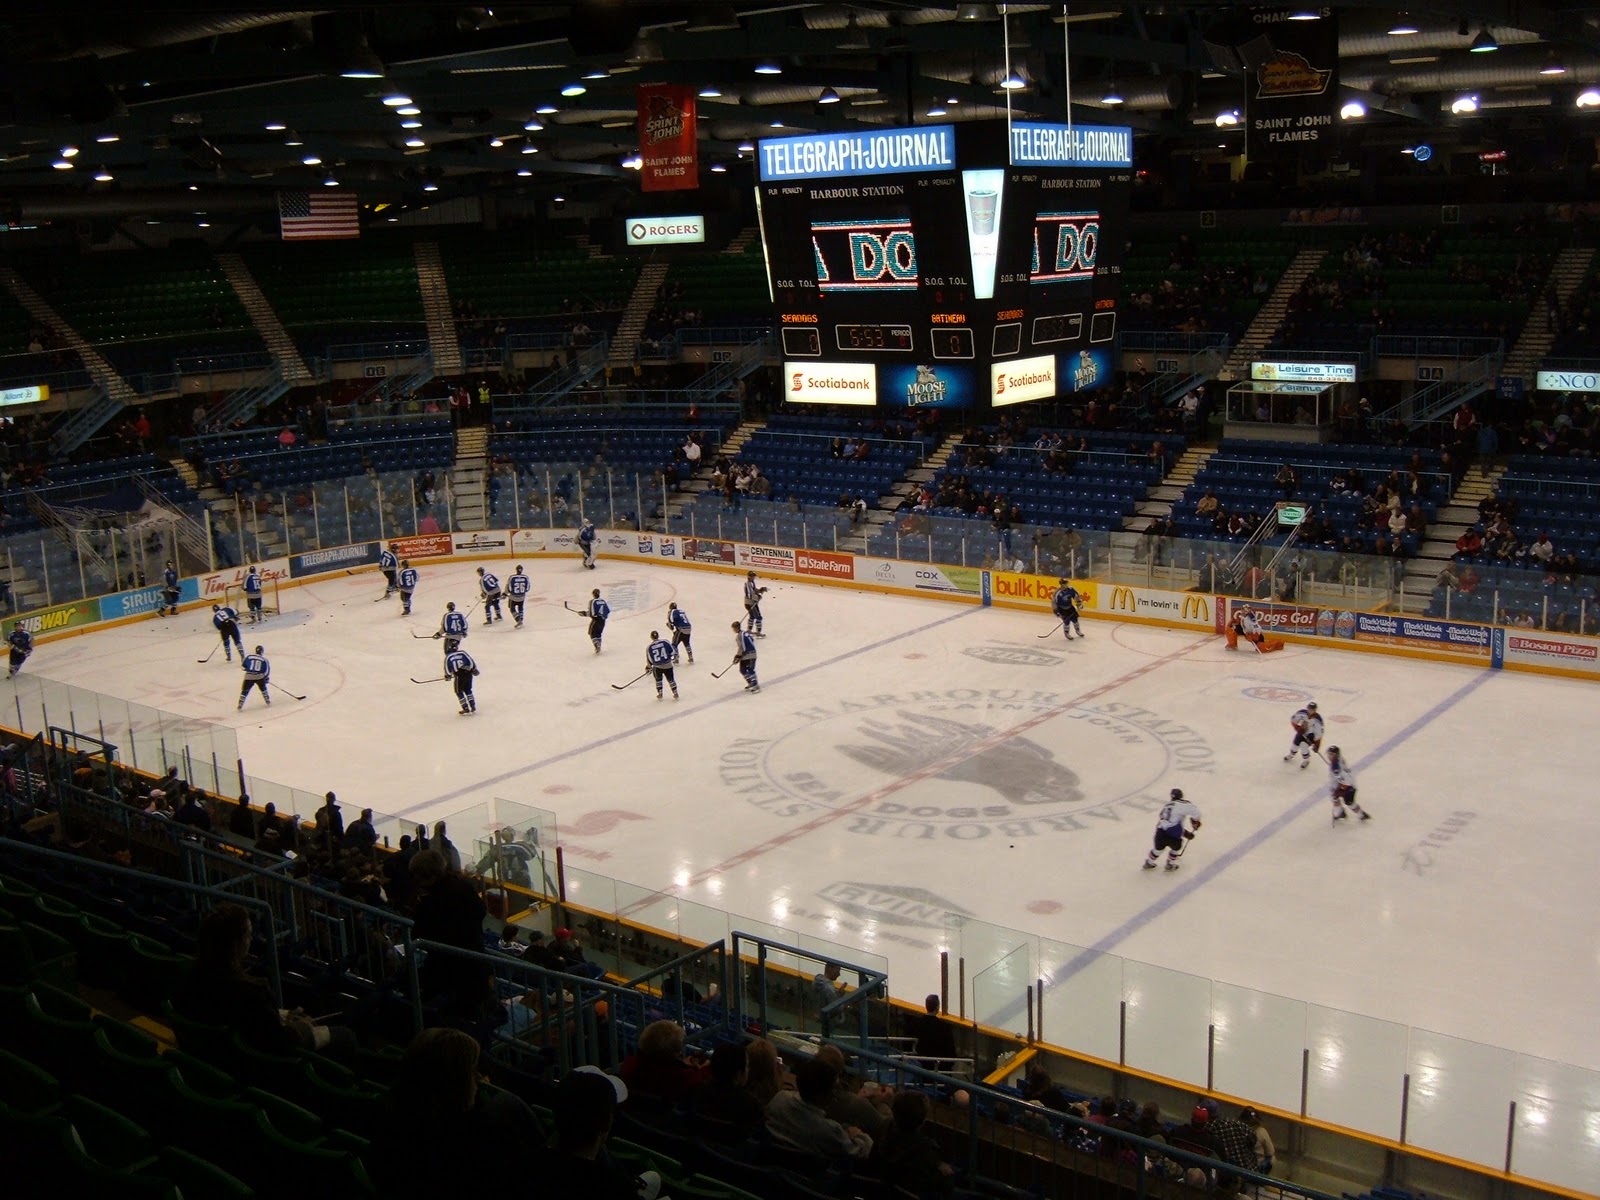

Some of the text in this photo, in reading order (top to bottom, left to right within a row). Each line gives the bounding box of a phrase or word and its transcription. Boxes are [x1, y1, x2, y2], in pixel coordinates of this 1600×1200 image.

[1255, 115, 1332, 130] SAINT JOHN
[653, 126, 683, 139] JOHN
[1269, 130, 1319, 142] FLAMES
[763, 131, 952, 176] TELEGRAPH-JOURNAL
[645, 156, 693, 167] SAINT JOHN
[653, 167, 686, 177] FLAMES
[1041, 179, 1102, 189] HARBOUR STATION
[810, 185, 905, 200] HARBOUR STATION
[650, 224, 699, 236] ROGERS
[781, 314, 818, 323] SEADOGS
[931, 314, 966, 324] GATINEAU
[1278, 364, 1353, 375] Leisure Time
[808, 377, 870, 390] Scotiabank
[1009, 371, 1052, 388] Scotiabank
[1559, 374, 1597, 389] NCO
[907, 380, 946, 396] MOOSE
[907, 391, 945, 407] LIGHT
[751, 547, 794, 559] CENTENNIAL
[405, 575, 416, 586] 21
[995, 575, 1033, 598] bulk
[1036, 580, 1058, 600] ba
[122, 590, 165, 610] SIRIUS
[1173, 602, 1179, 610] it
[21, 607, 77, 633] UBWAY
[1254, 610, 1288, 627] Dogs
[1290, 612, 1315, 624] Go!
[652, 647, 669, 662] 24
[1520, 640, 1595, 656] Boston Pizza
[1067, 712, 1144, 745] JOHN
[1093, 702, 1217, 774] STATION
[873, 801, 1012, 819] DOGS
